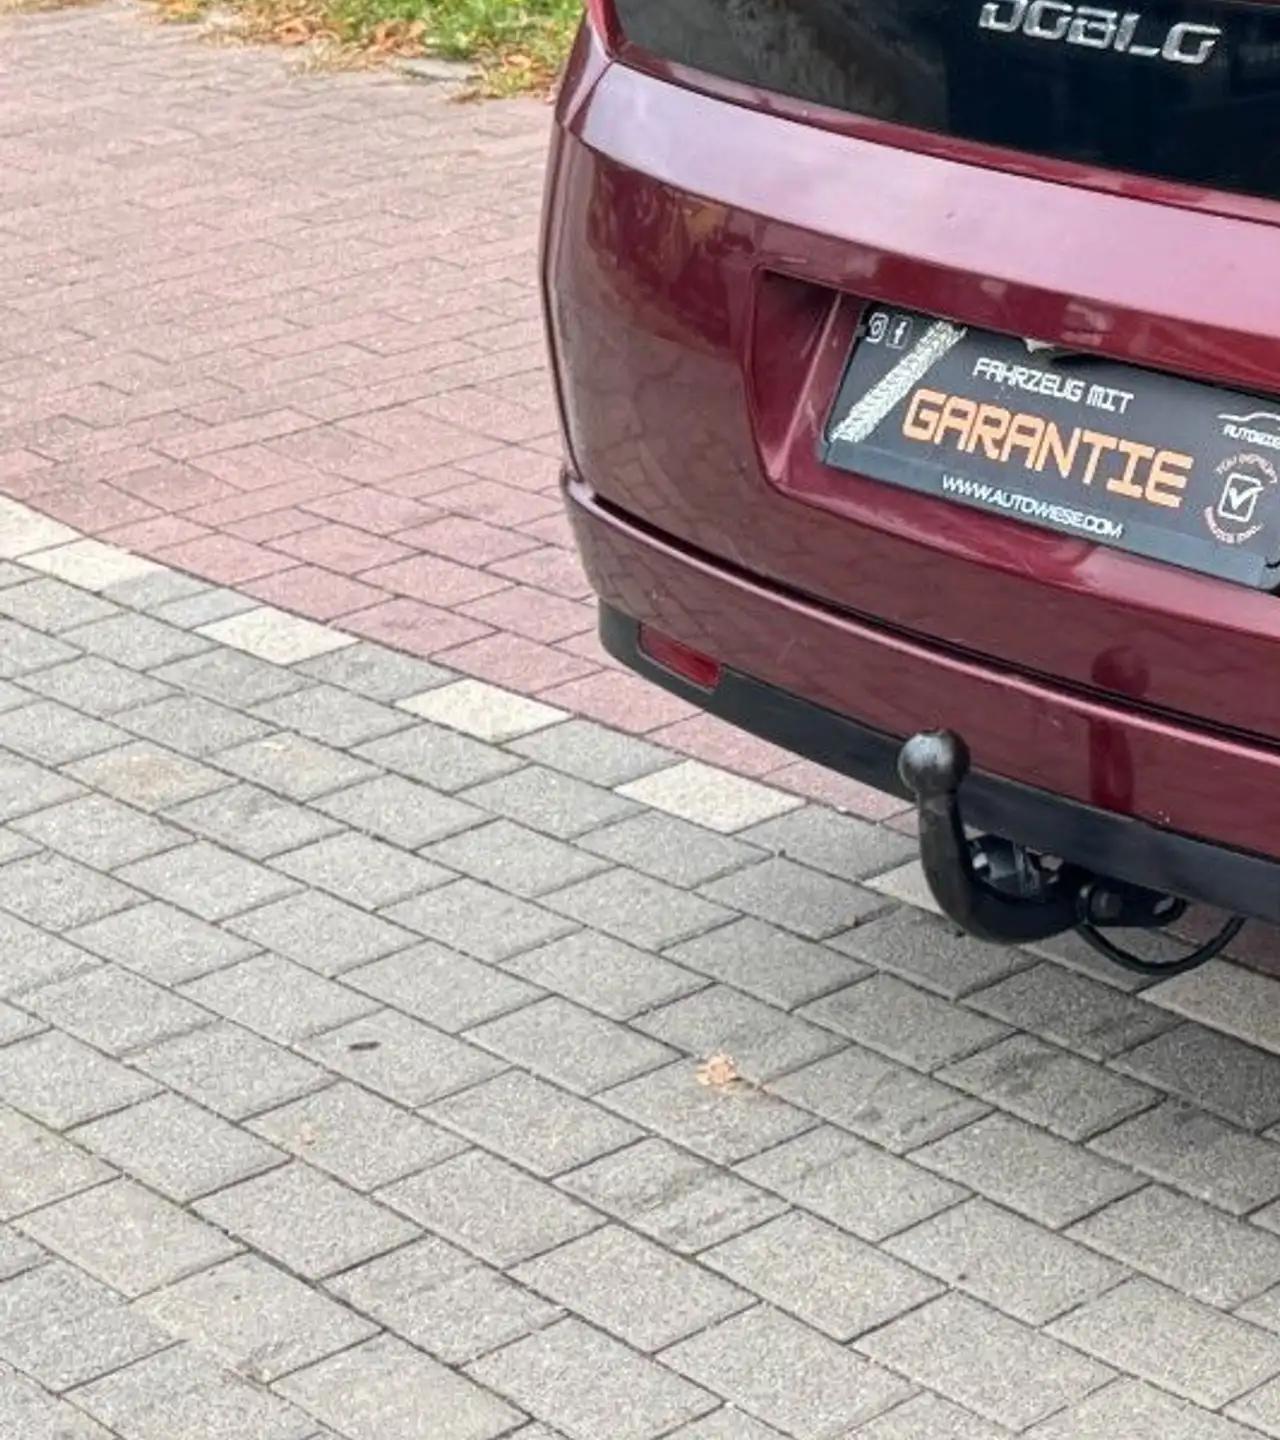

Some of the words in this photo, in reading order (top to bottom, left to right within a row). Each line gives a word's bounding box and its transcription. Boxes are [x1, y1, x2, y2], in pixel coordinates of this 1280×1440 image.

[972, 357, 1086, 403] FAHRZEUG
[1086, 384, 1134, 414] MIT
[902, 388, 1195, 509] GARANTIE
[942, 473, 1125, 540] WWW.AUTOWIESE.COM
